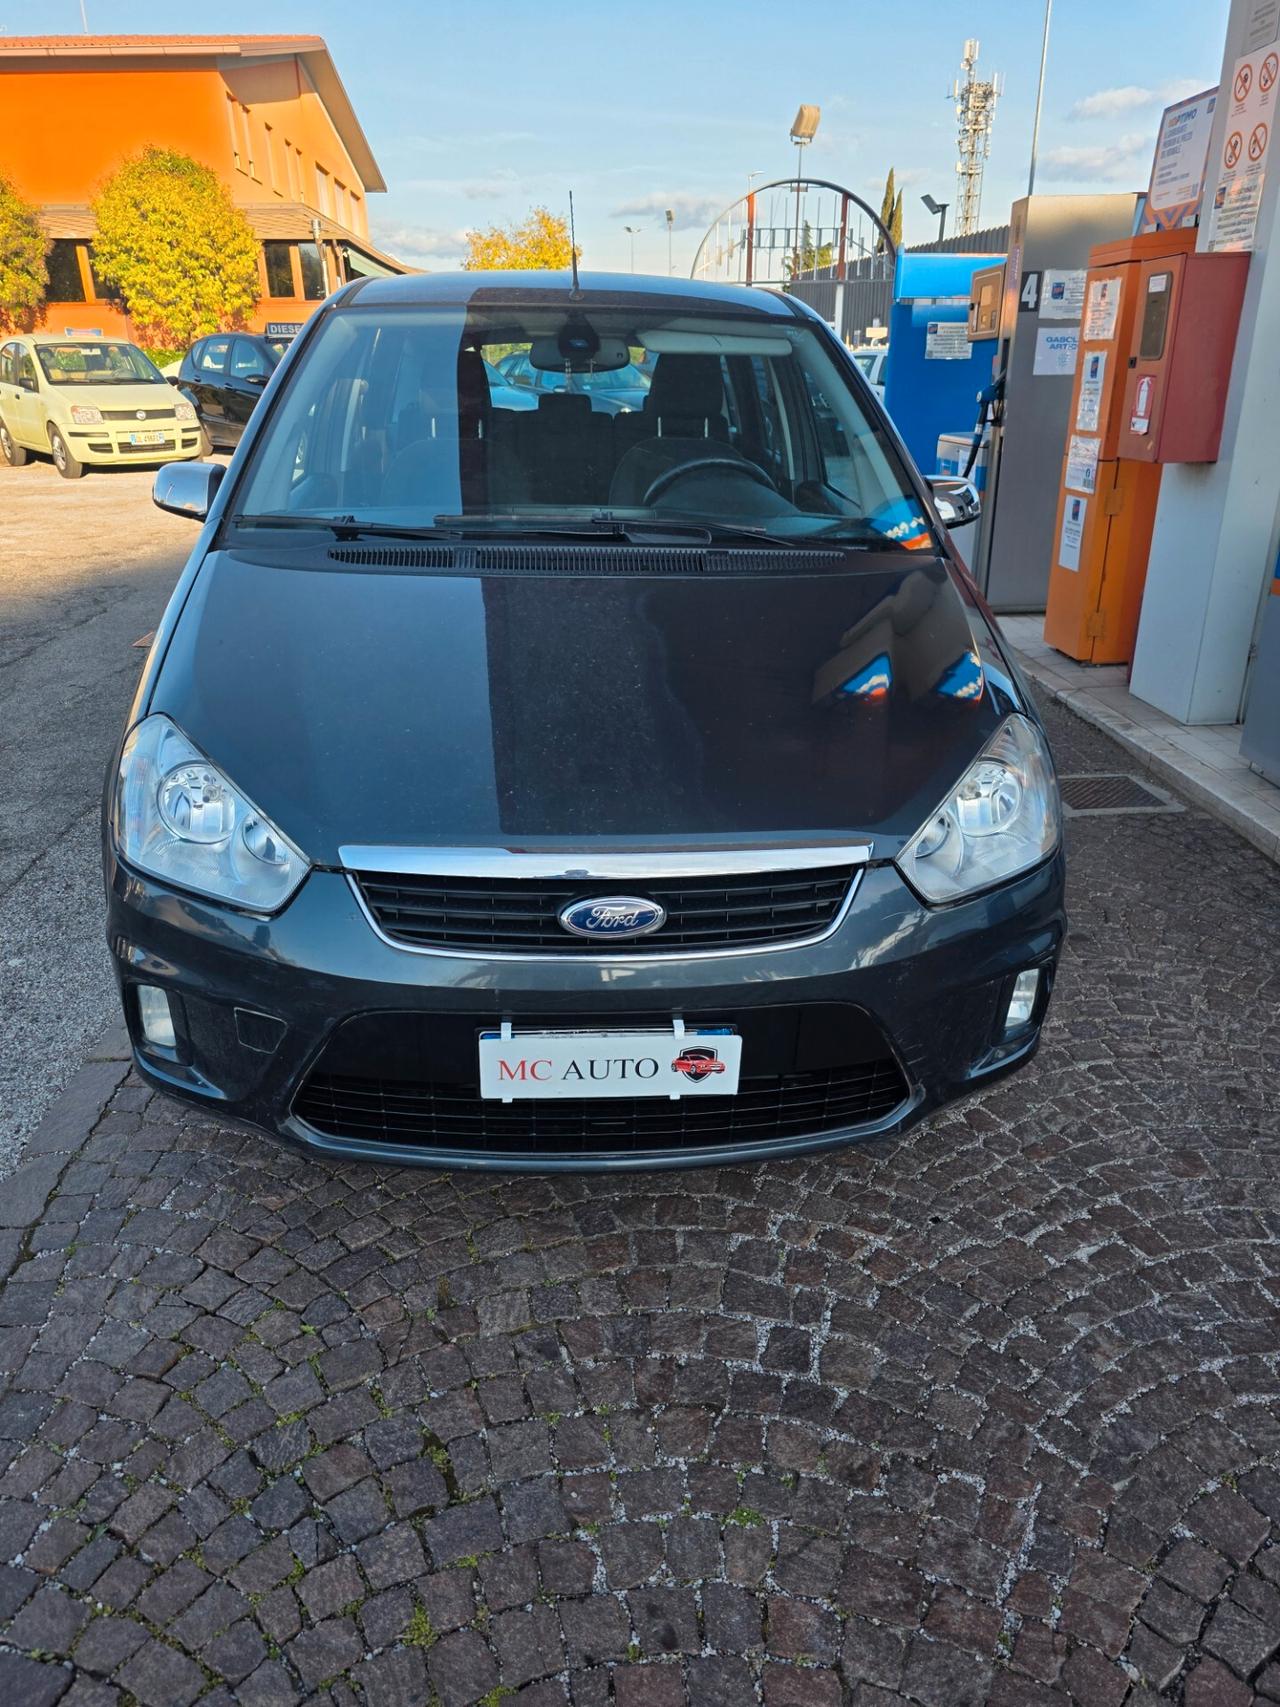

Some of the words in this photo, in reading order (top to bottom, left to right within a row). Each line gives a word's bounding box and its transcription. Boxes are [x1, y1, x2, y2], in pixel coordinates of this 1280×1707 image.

[1021, 274, 1038, 308] 4
[586, 906, 639, 928] Ford
[497, 1059, 552, 1081] MC
[562, 1057, 659, 1080] AUTO
